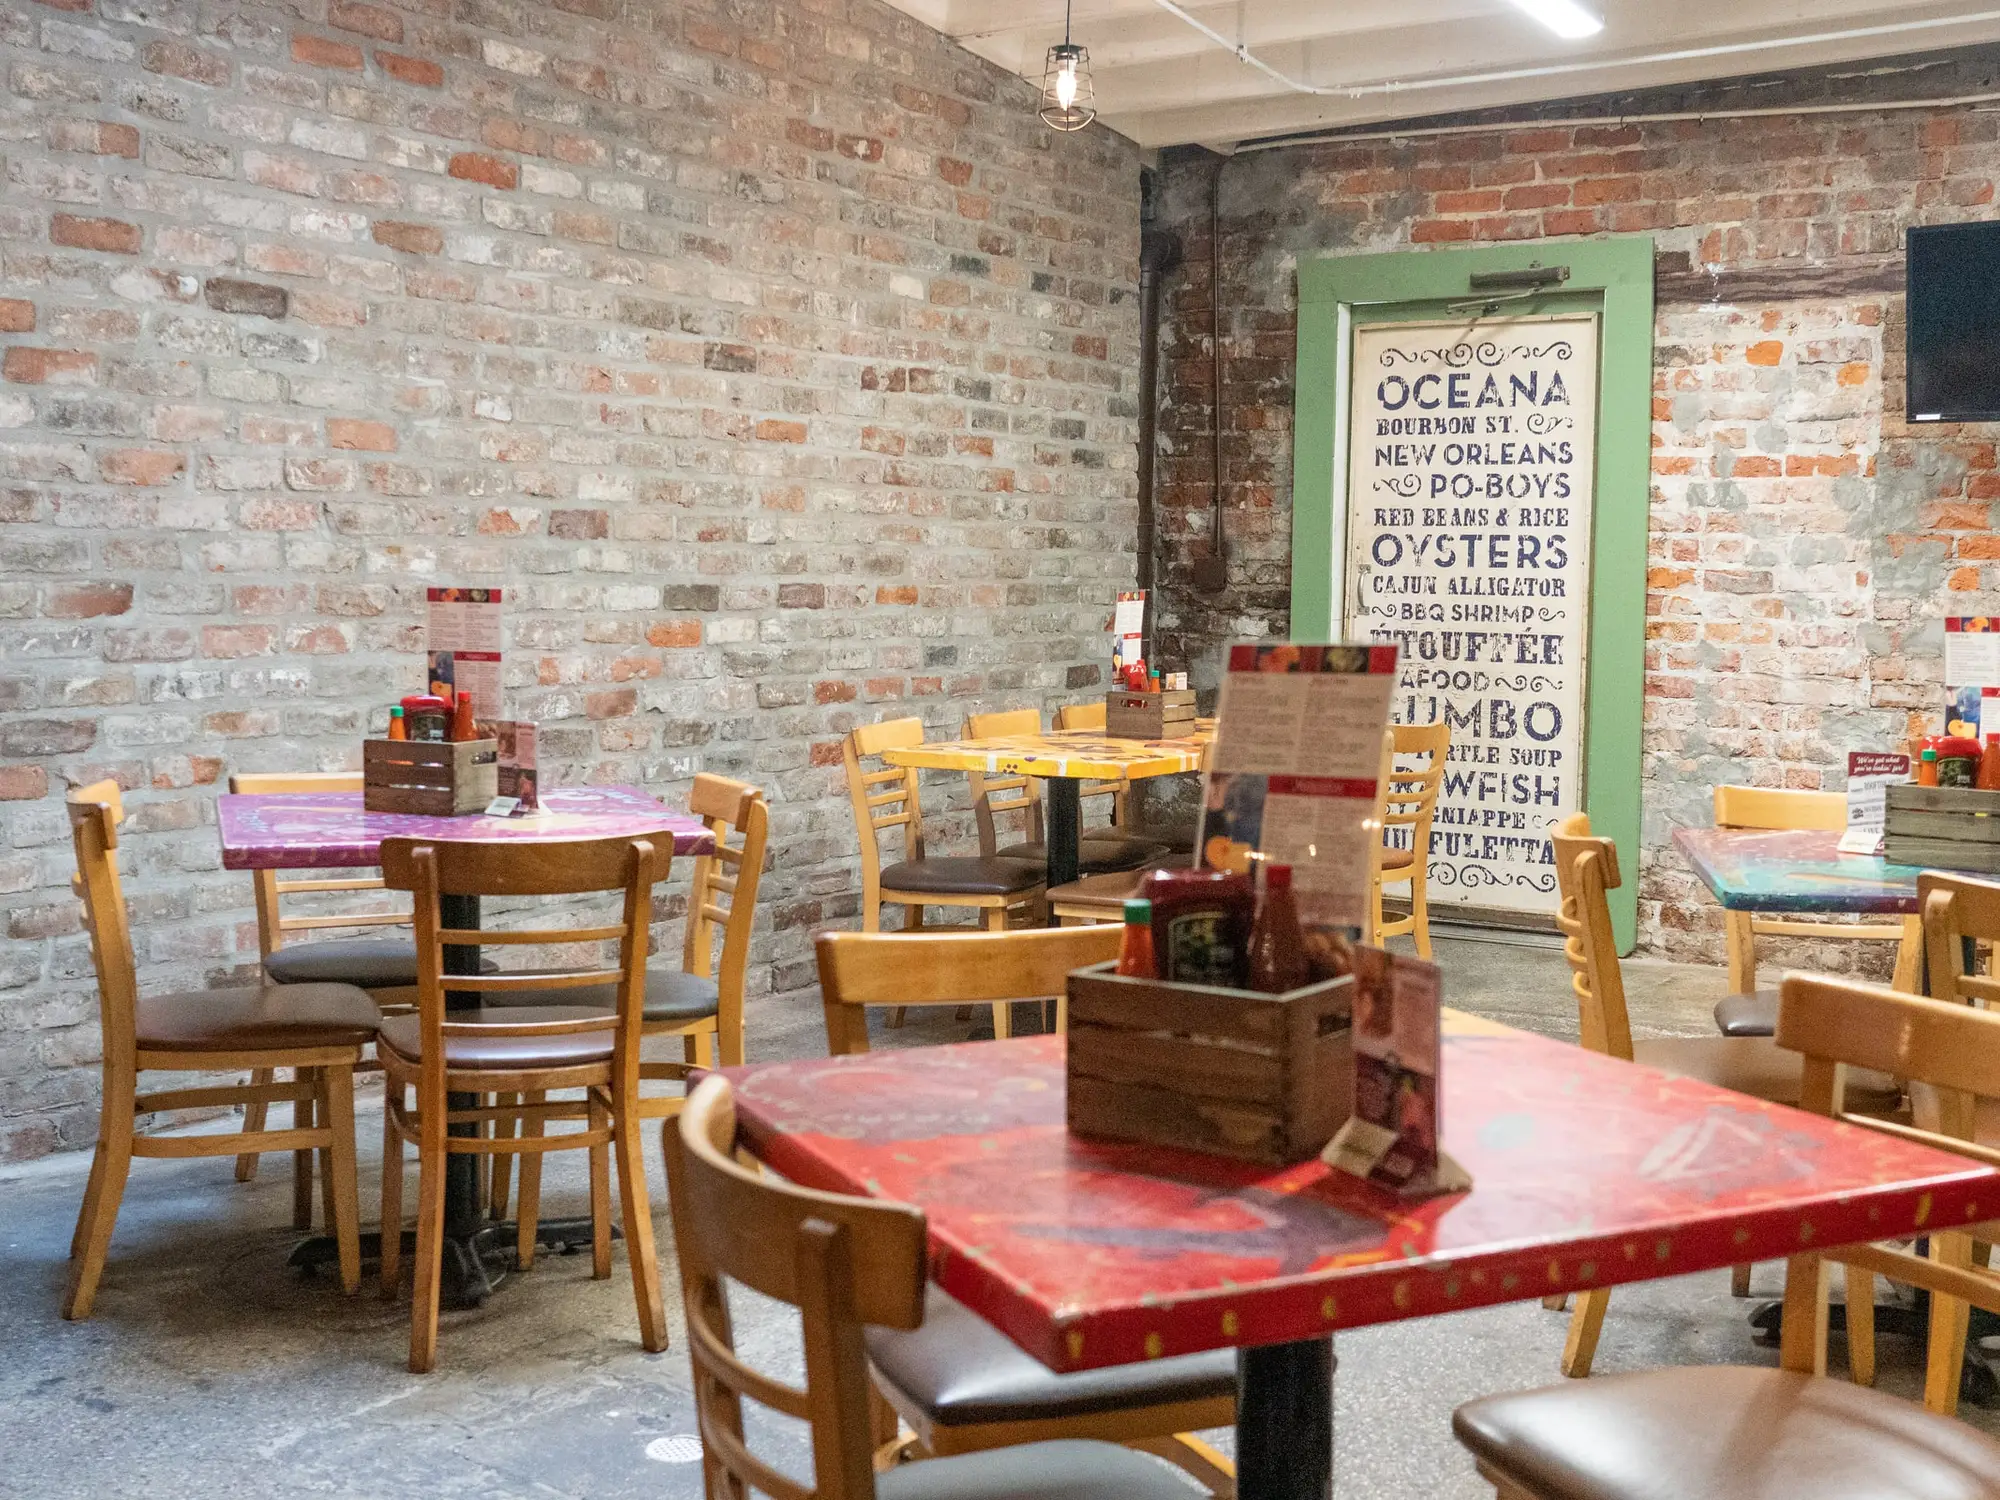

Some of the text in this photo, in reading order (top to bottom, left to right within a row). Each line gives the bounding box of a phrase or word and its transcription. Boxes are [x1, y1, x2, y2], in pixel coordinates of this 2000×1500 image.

[1377, 370, 1570, 410] OCEANA
[1376, 416, 1519, 436] BOURBON ST.
[1375, 441, 1573, 467] NEW ORLEANS
[1430, 472, 1571, 499] PO-BOYS
[1374, 507, 1569, 527] RED BEANS & RICE
[1372, 533, 1568, 569] OYSTERS
[1373, 575, 1566, 597] CAJUN ALLIGATOR
[1401, 603, 1534, 623] BBQ SHRIMP
[1400, 669, 1490, 691] AFOOD
[1509, 748, 1562, 768] SOUP
